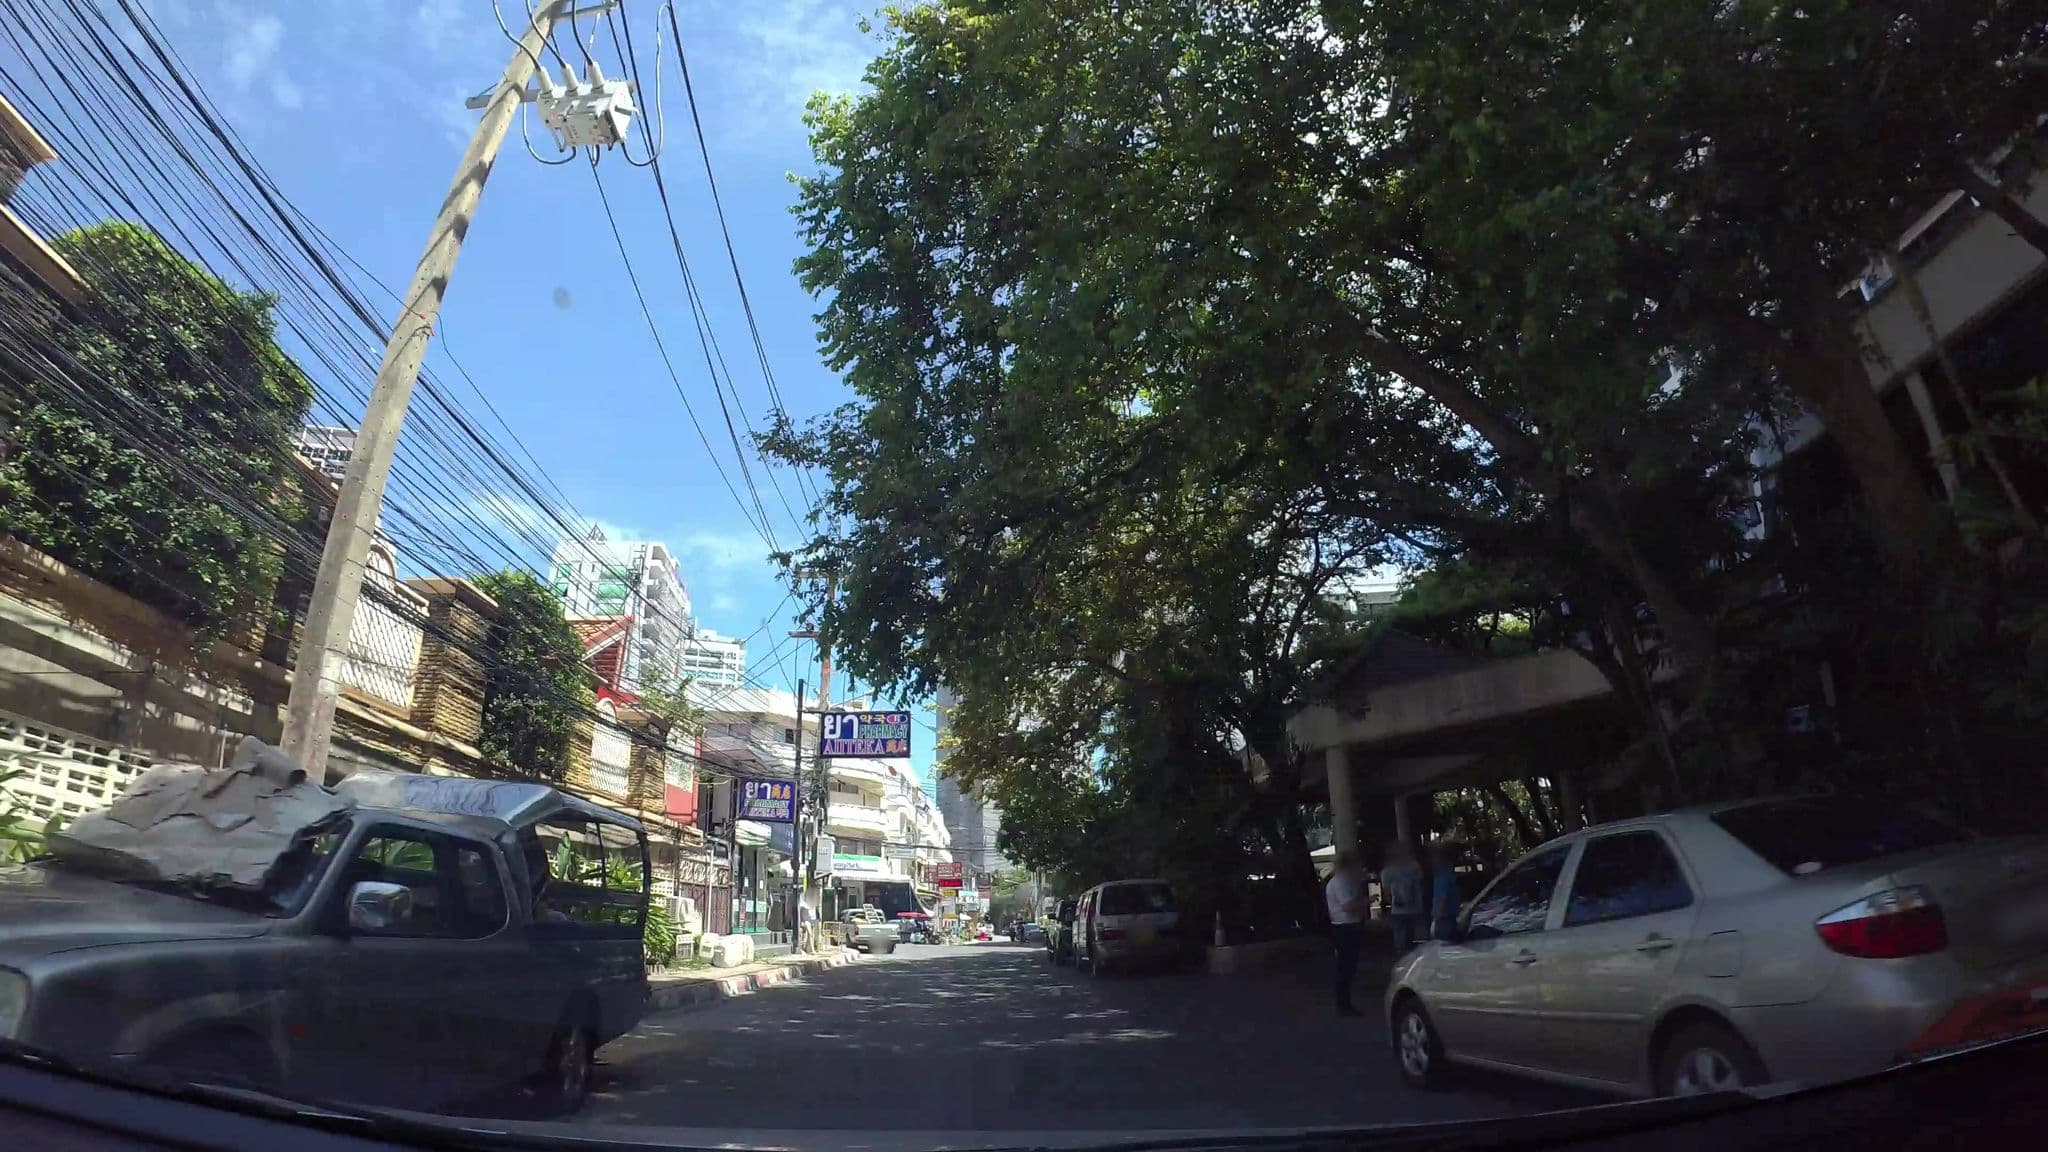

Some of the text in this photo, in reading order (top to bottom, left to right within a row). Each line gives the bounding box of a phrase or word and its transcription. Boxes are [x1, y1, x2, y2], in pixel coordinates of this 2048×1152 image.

[824, 714, 859, 739] ยา
[859, 724, 908, 738] PHARMACY
[745, 782, 771, 799] ยา
